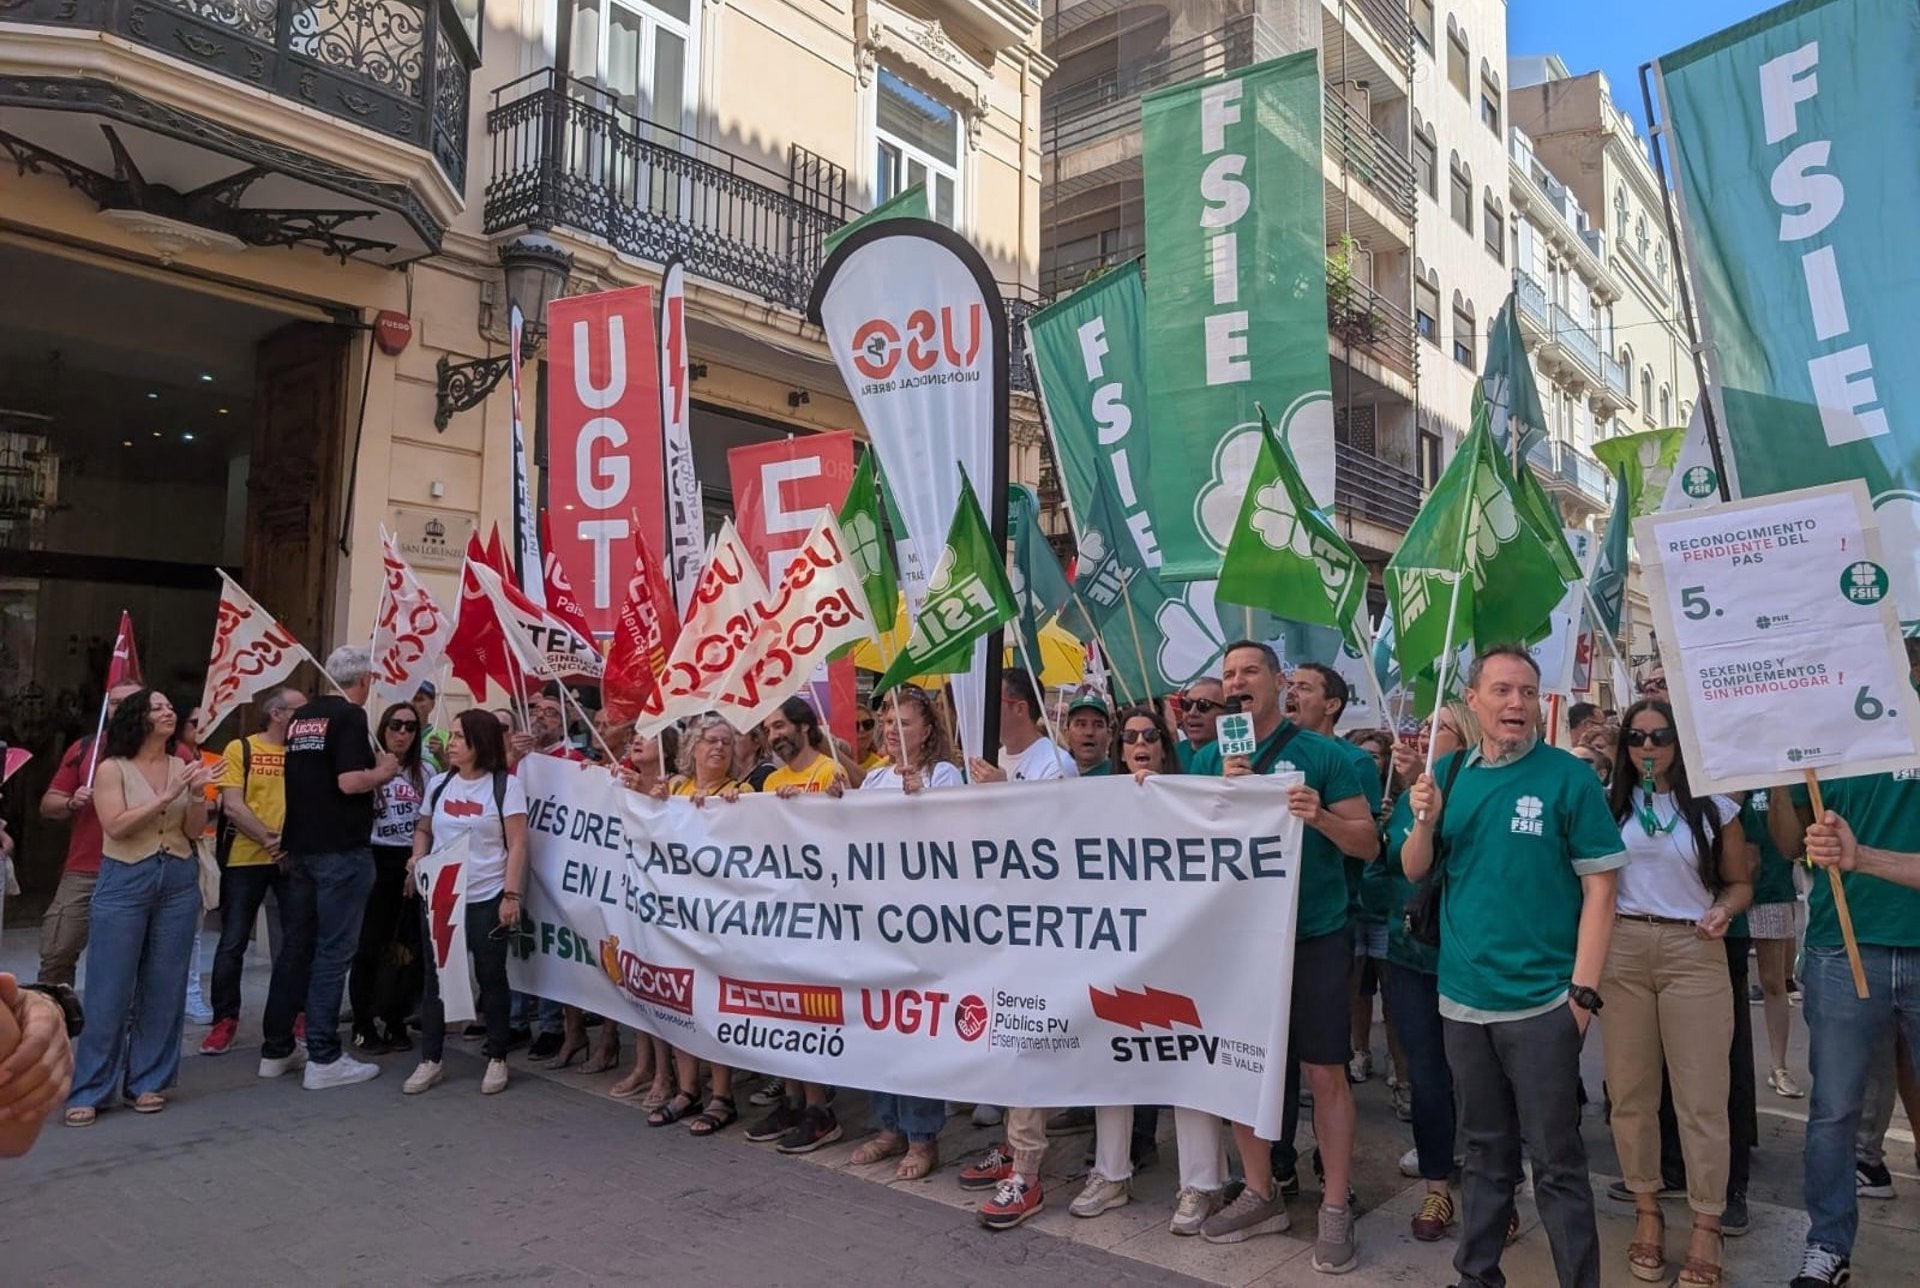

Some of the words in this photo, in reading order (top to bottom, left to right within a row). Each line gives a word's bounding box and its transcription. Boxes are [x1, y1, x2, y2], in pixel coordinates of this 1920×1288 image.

[1199, 79, 1251, 386] FSIE
[1759, 41, 1890, 447] FSIE
[381, 320, 410, 331] FUEGO
[1077, 315, 1162, 568] FSIE
[572, 315, 632, 610] UGT
[1669, 519, 1817, 553] RECONOCIMIENTO
[1683, 538, 1774, 563] PENDIENTE
[1778, 533, 1809, 548] DEL
[1732, 552, 1764, 567] PAS
[1681, 585, 1724, 621] 5.
[1850, 587, 1880, 599] FSIE
[517, 619, 603, 664] TEP
[1699, 659, 1772, 679] SEXENIOS
[1776, 657, 1786, 668] Y
[1702, 663, 1827, 690] COMPLEMENTOS
[1704, 688, 1729, 701] SIN
[1733, 675, 1830, 698] HOMOLOGAR
[1854, 685, 1897, 721] 6.
[1222, 740, 1254, 753] FSIE
[527, 795, 568, 836] MÉS
[570, 809, 634, 860] DRE
[848, 841, 885, 882] NI
[900, 840, 958, 881] UN
[972, 838, 1060, 881] PAS
[1075, 834, 1287, 883] ENRERE
[1511, 819, 1543, 833] FSIE
[562, 859, 598, 898] EN
[877, 903, 1147, 953] CONCERTAT
[725, 985, 800, 1014] CCOO
[861, 988, 949, 1037] UGT
[996, 990, 1047, 1011] Serveis
[717, 1017, 845, 1057] educació
[994, 1012, 1044, 1033] Públics
[1047, 1017, 1069, 1033] PV
[1052, 1036, 1080, 1053] privat
[1111, 1034, 1220, 1065] STEPV
[1220, 1038, 1268, 1058] INTERSIN
